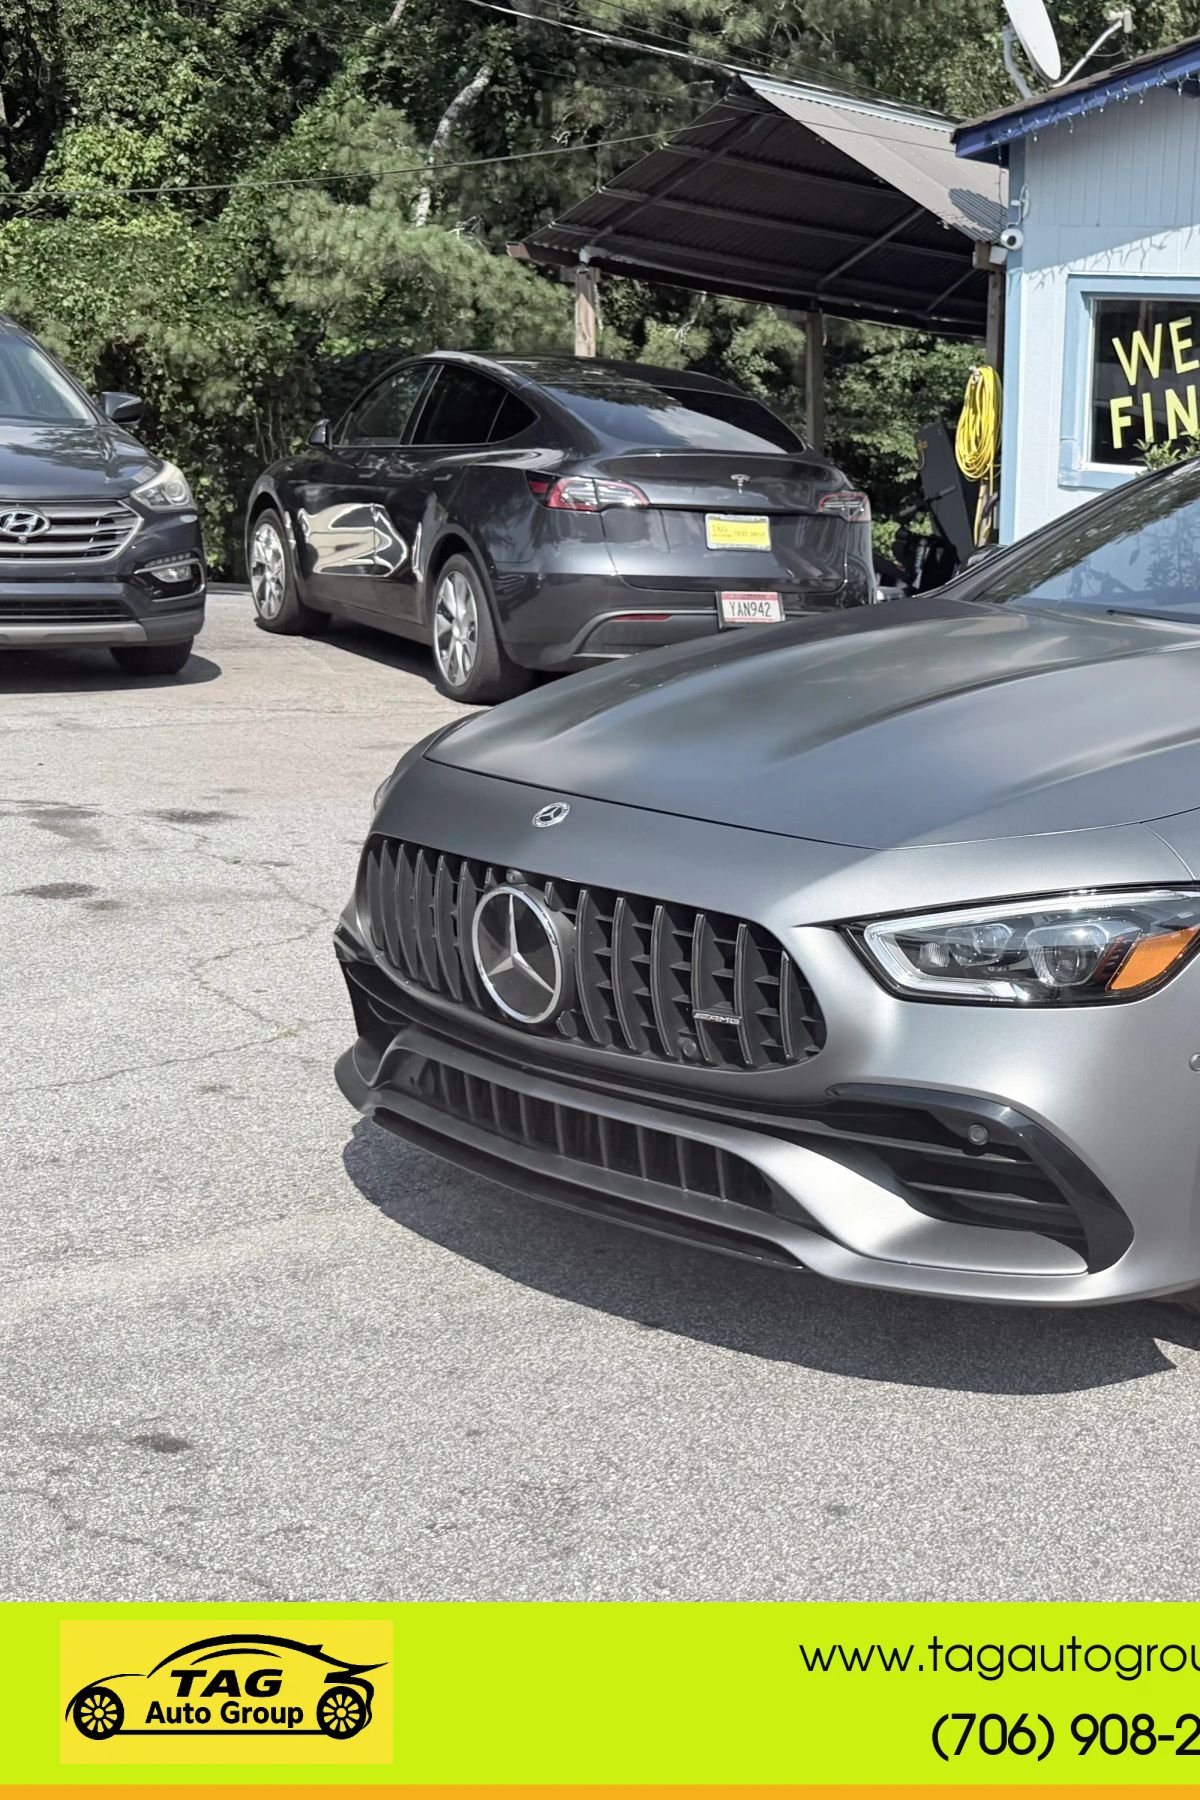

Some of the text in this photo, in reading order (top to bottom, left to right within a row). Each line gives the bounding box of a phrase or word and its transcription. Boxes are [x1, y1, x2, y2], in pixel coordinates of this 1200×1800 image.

[1111, 316, 1200, 386] WE
[729, 601, 772, 617] YAN942
[709, 1015, 740, 1025] AMG
